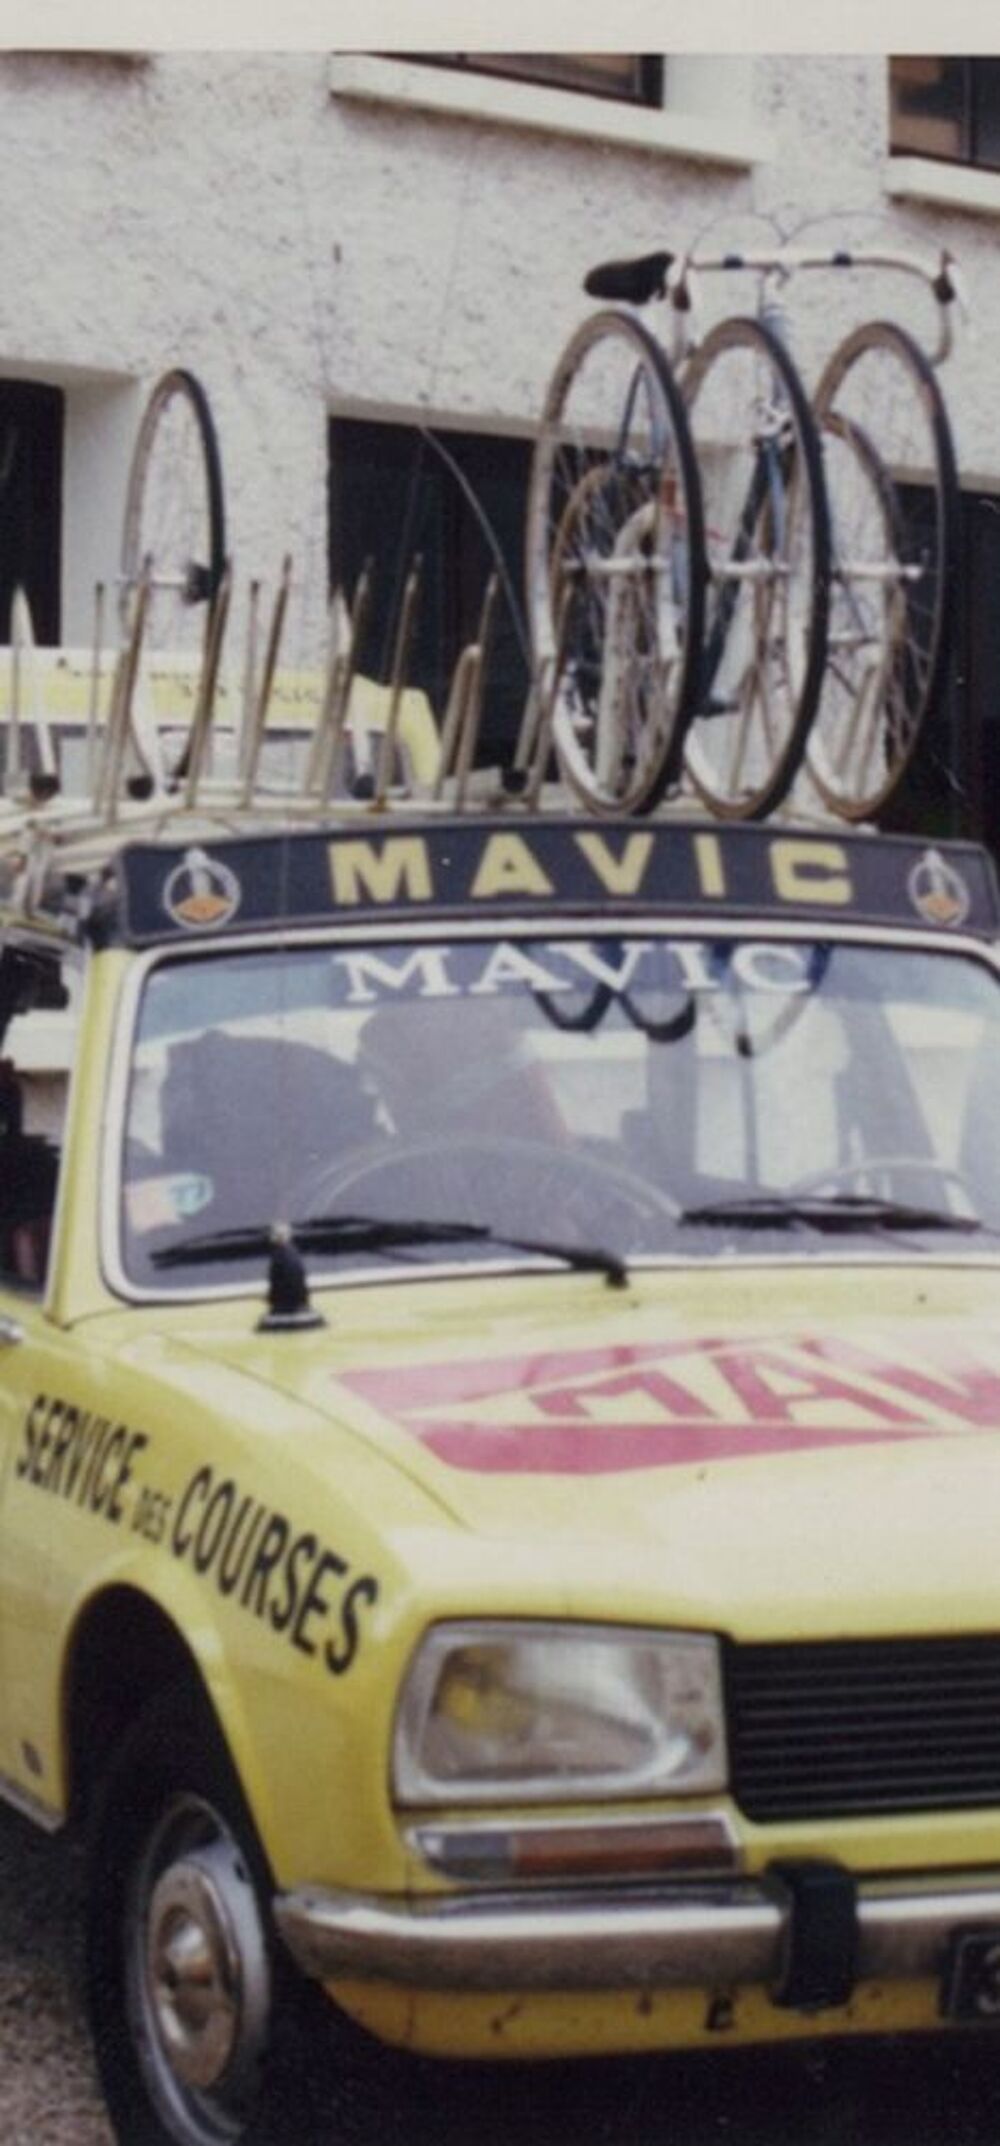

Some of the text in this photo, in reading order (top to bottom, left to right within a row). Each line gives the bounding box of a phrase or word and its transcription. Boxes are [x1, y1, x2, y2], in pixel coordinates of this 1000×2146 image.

[328, 832, 852, 904] MAVIC
[333, 940, 812, 1002] MAVIC
[16, 1394, 378, 1675] SERVICE DES COURSES
